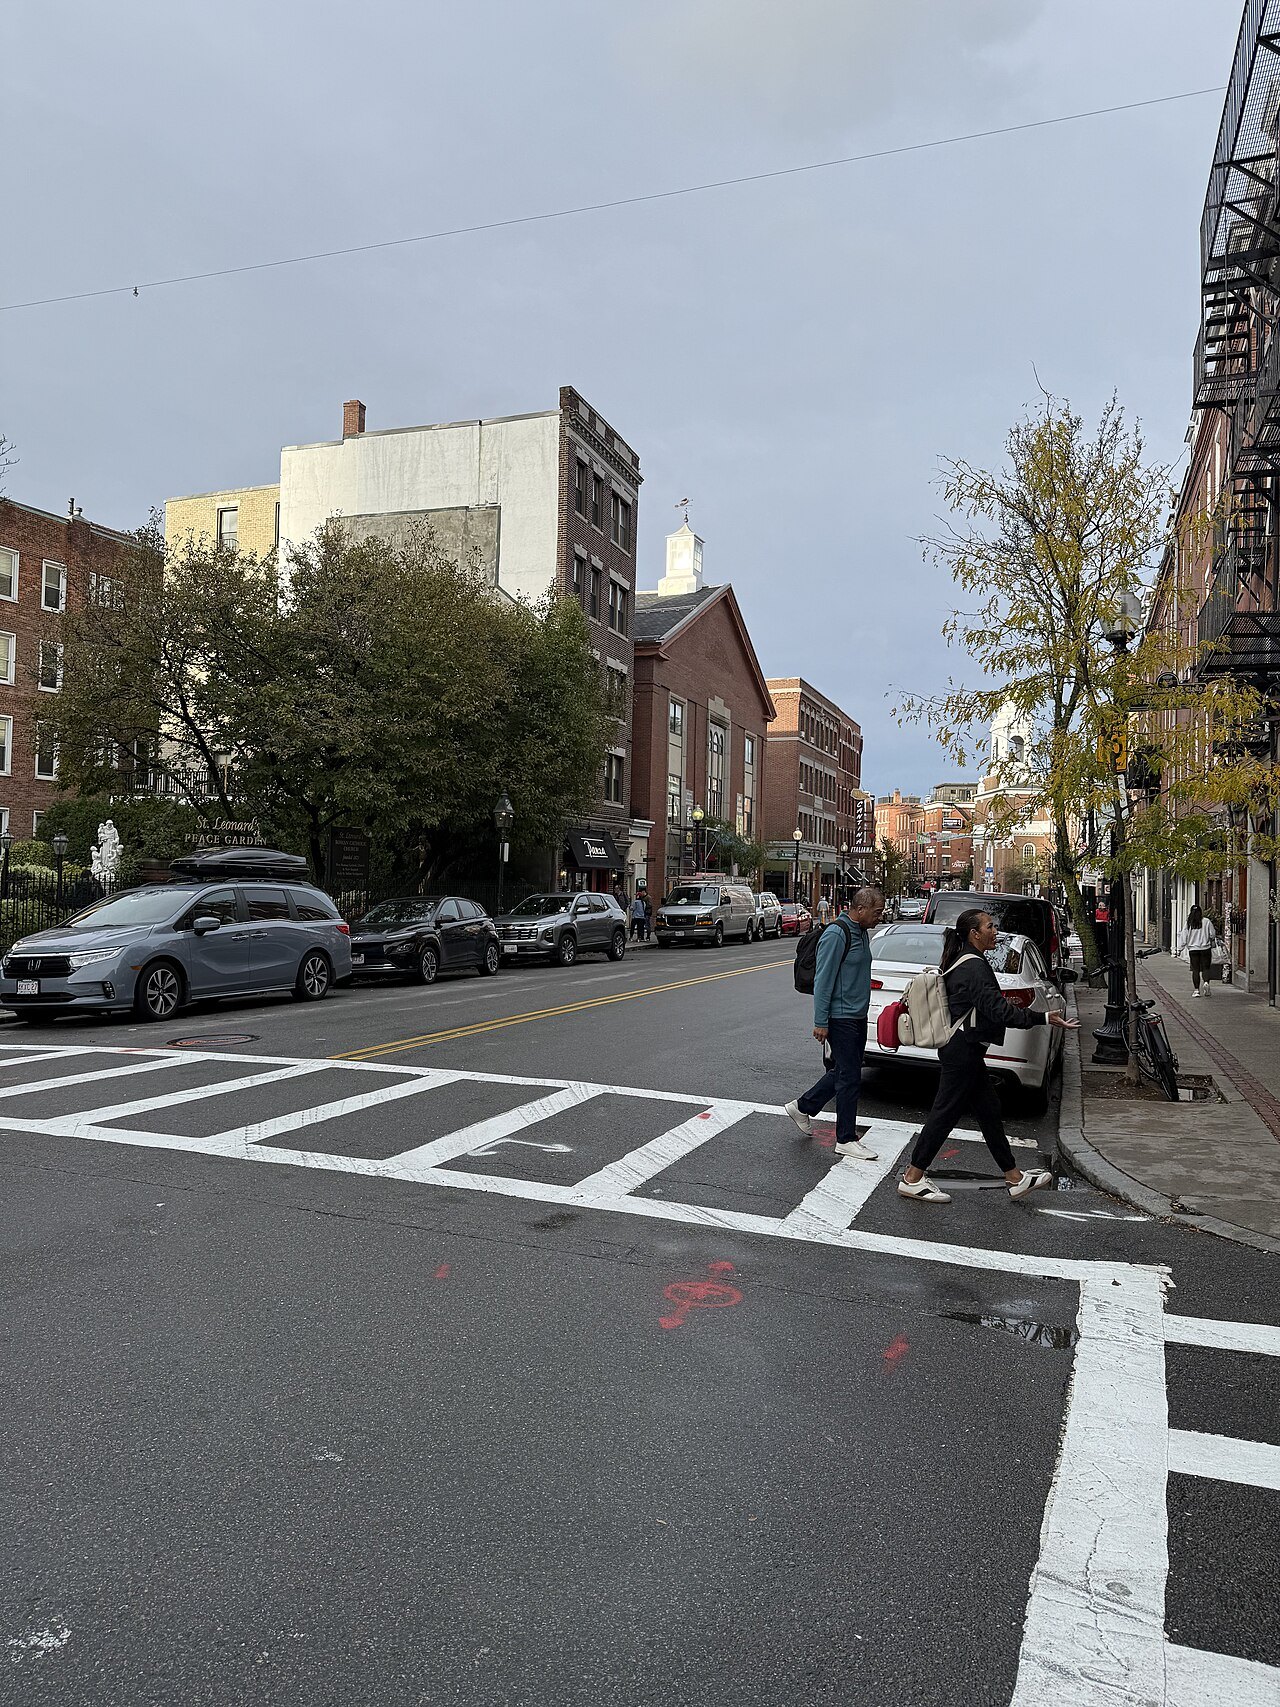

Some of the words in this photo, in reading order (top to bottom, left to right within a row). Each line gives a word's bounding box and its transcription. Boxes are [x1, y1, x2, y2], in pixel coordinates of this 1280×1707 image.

[195, 815, 210, 829] St.
[212, 816, 261, 834] Leonard's
[184, 833, 220, 844] PEACE
[224, 835, 267, 846] GARDEN
